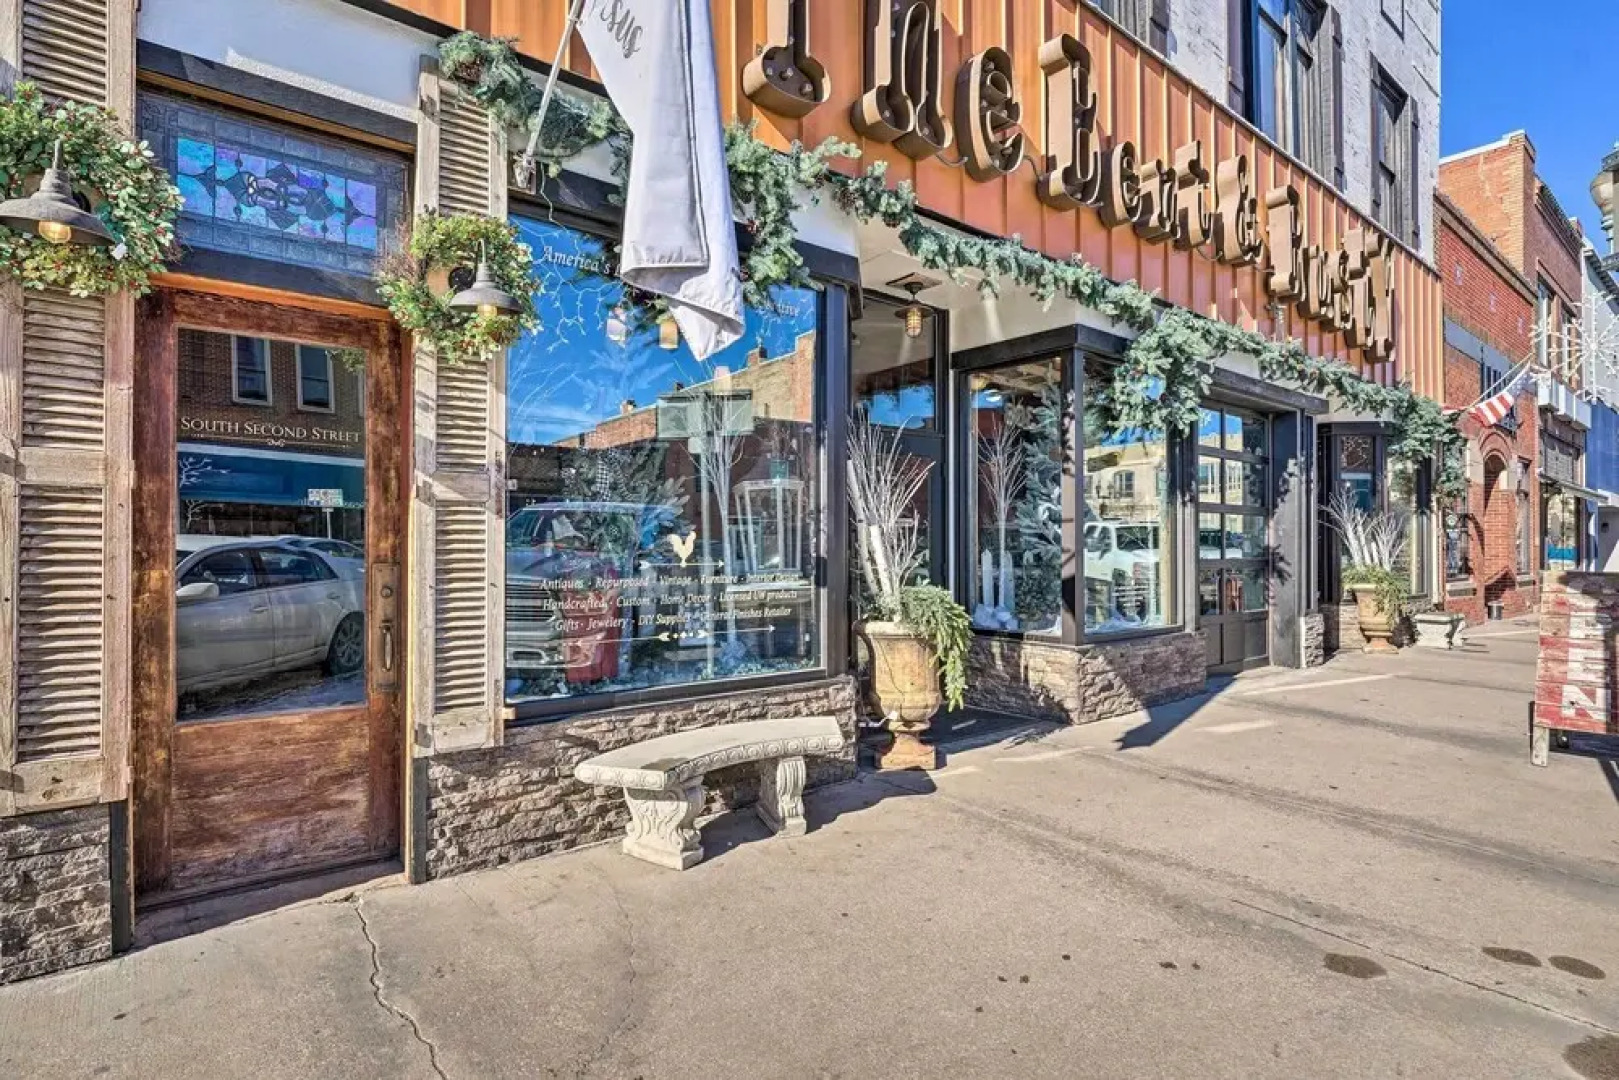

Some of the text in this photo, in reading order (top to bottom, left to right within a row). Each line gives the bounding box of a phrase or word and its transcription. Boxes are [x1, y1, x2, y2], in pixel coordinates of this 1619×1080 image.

[542, 245, 612, 275] America's
[180, 416, 362, 443] SOUTH SECOND STREET
[539, 579, 584, 590] Antiques
[596, 577, 649, 589] Repurposed
[616, 595, 650, 607] Custom
[660, 594, 685, 606] Home
[720, 591, 751, 602] Licensed
[767, 588, 798, 600] products
[556, 619, 579, 632] Gifts
[764, 606, 793, 618] Retailer
